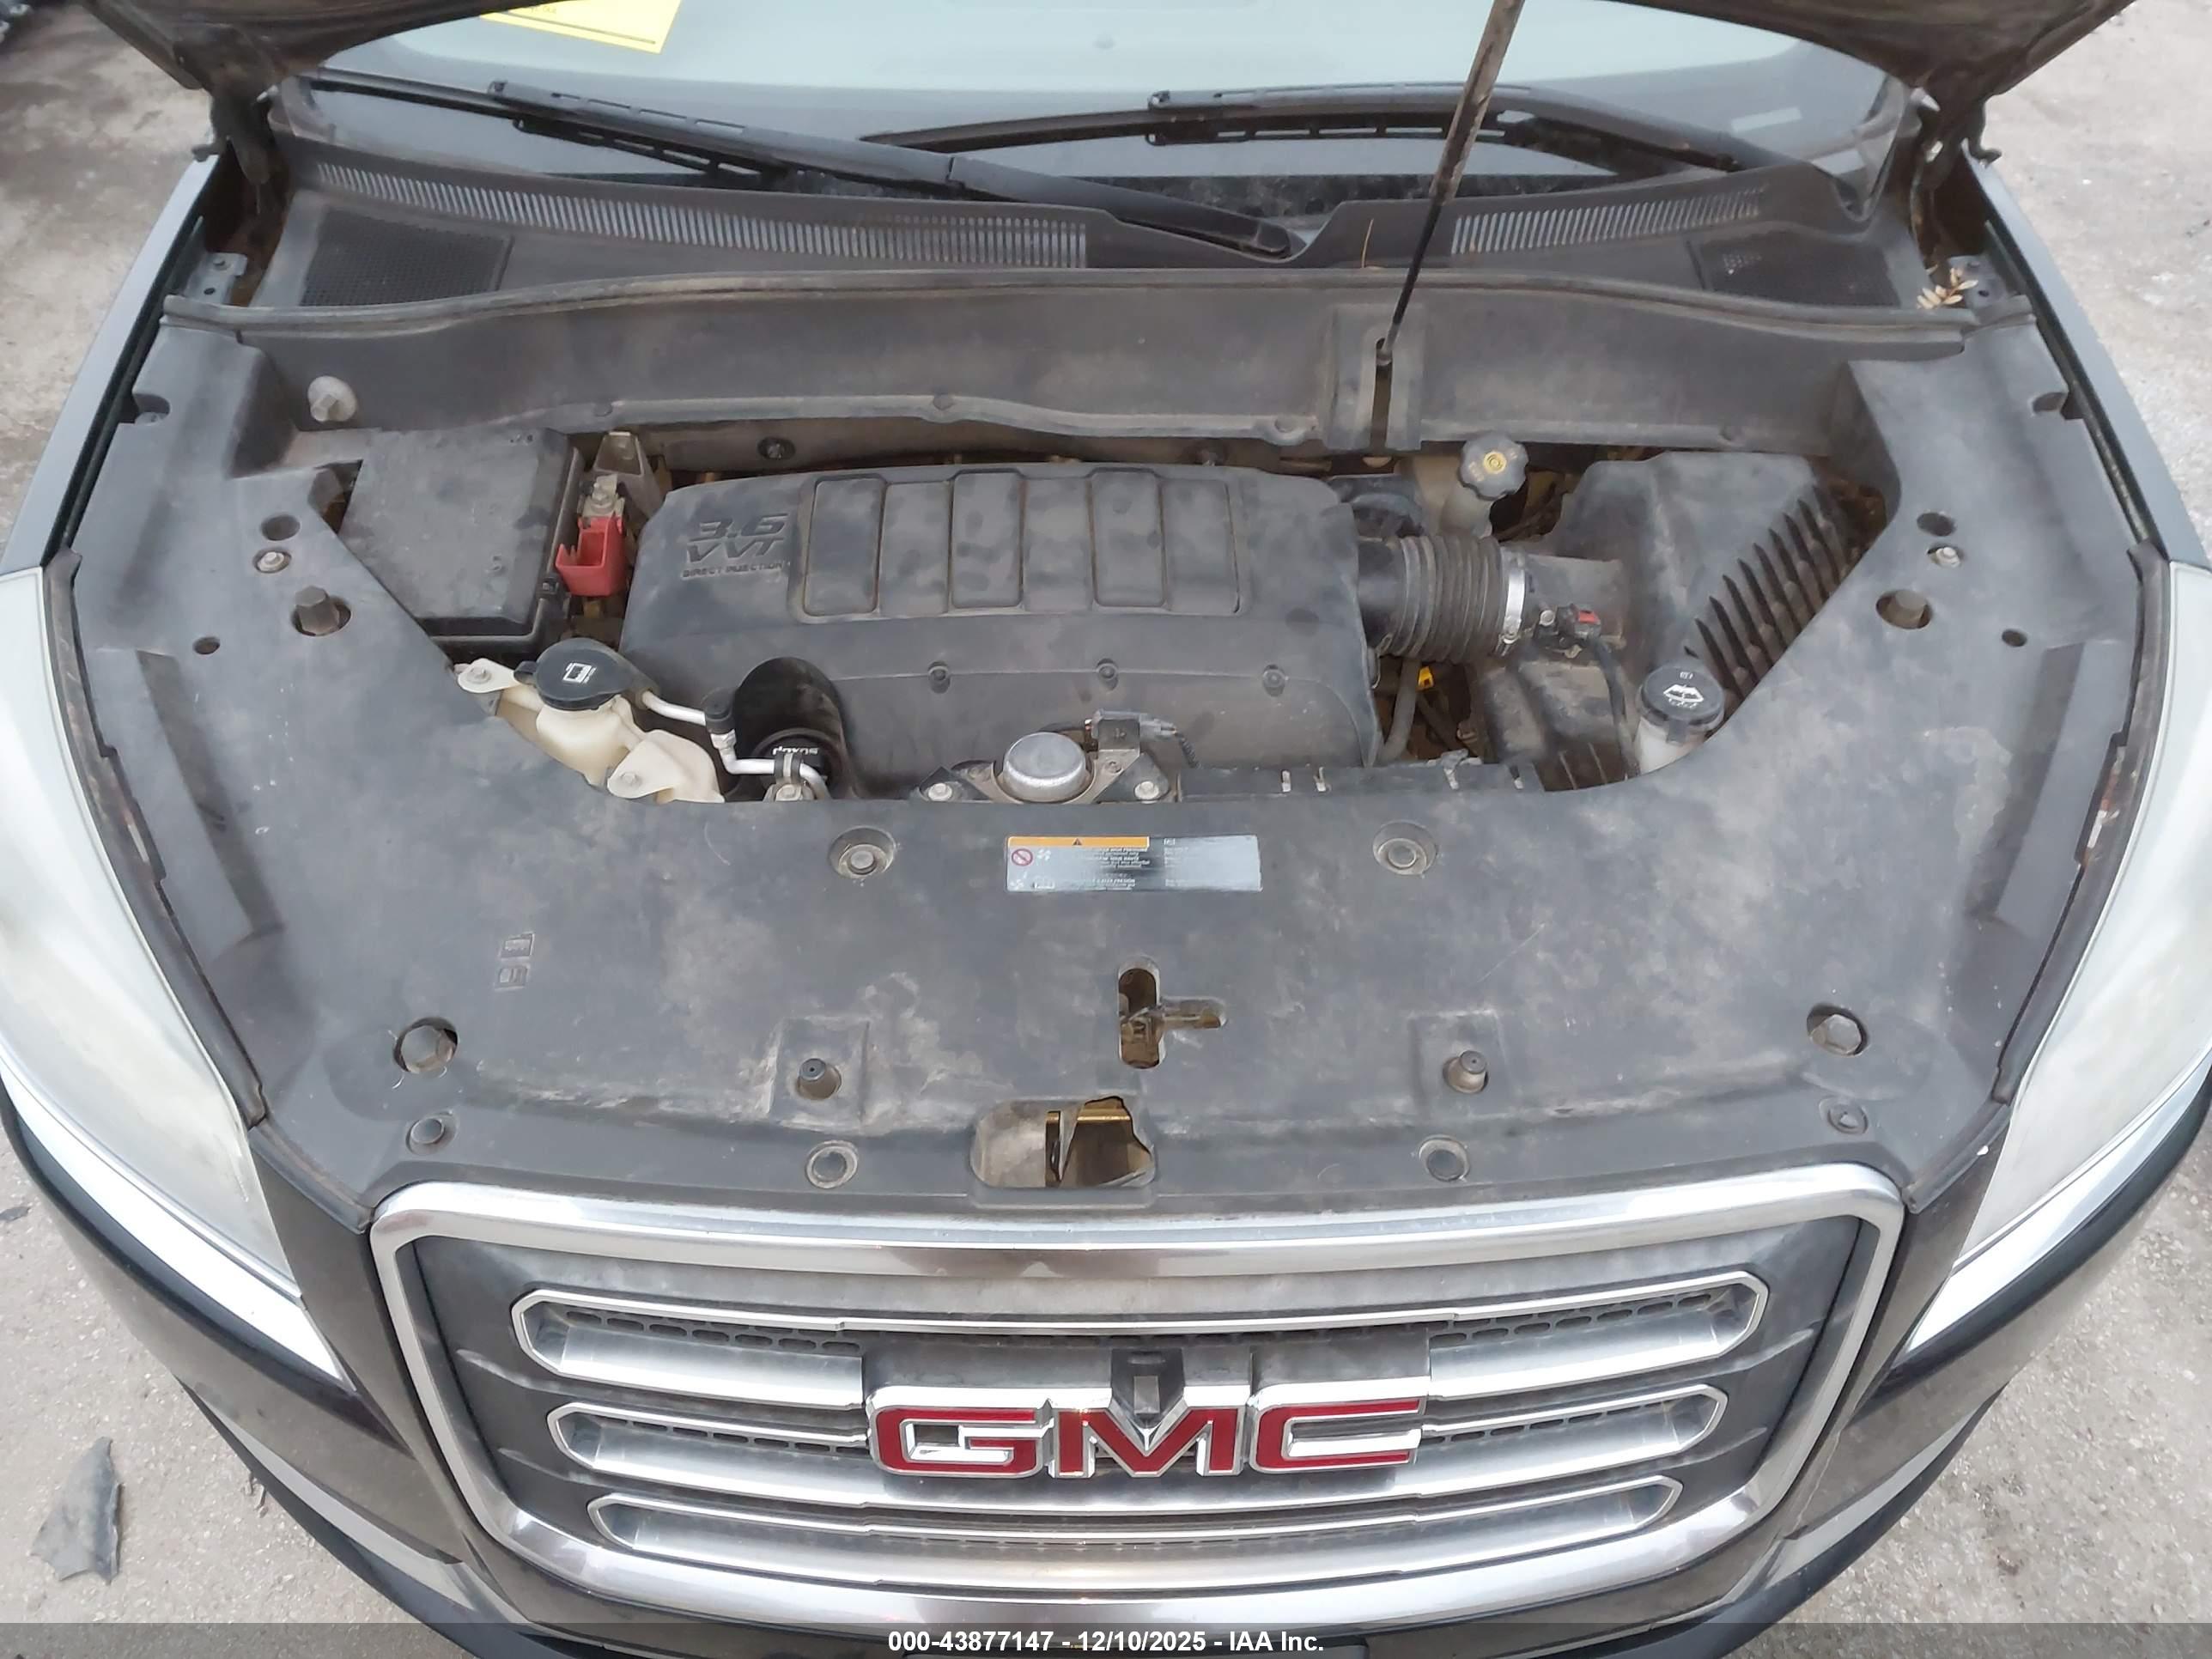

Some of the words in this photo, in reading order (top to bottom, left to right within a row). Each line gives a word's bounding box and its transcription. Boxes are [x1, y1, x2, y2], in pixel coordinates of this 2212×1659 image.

[690, 514, 789, 542] 3.6
[686, 536, 785, 562] VVT
[682, 567, 722, 579] DIRECT
[866, 1382, 1427, 1477] GMC
